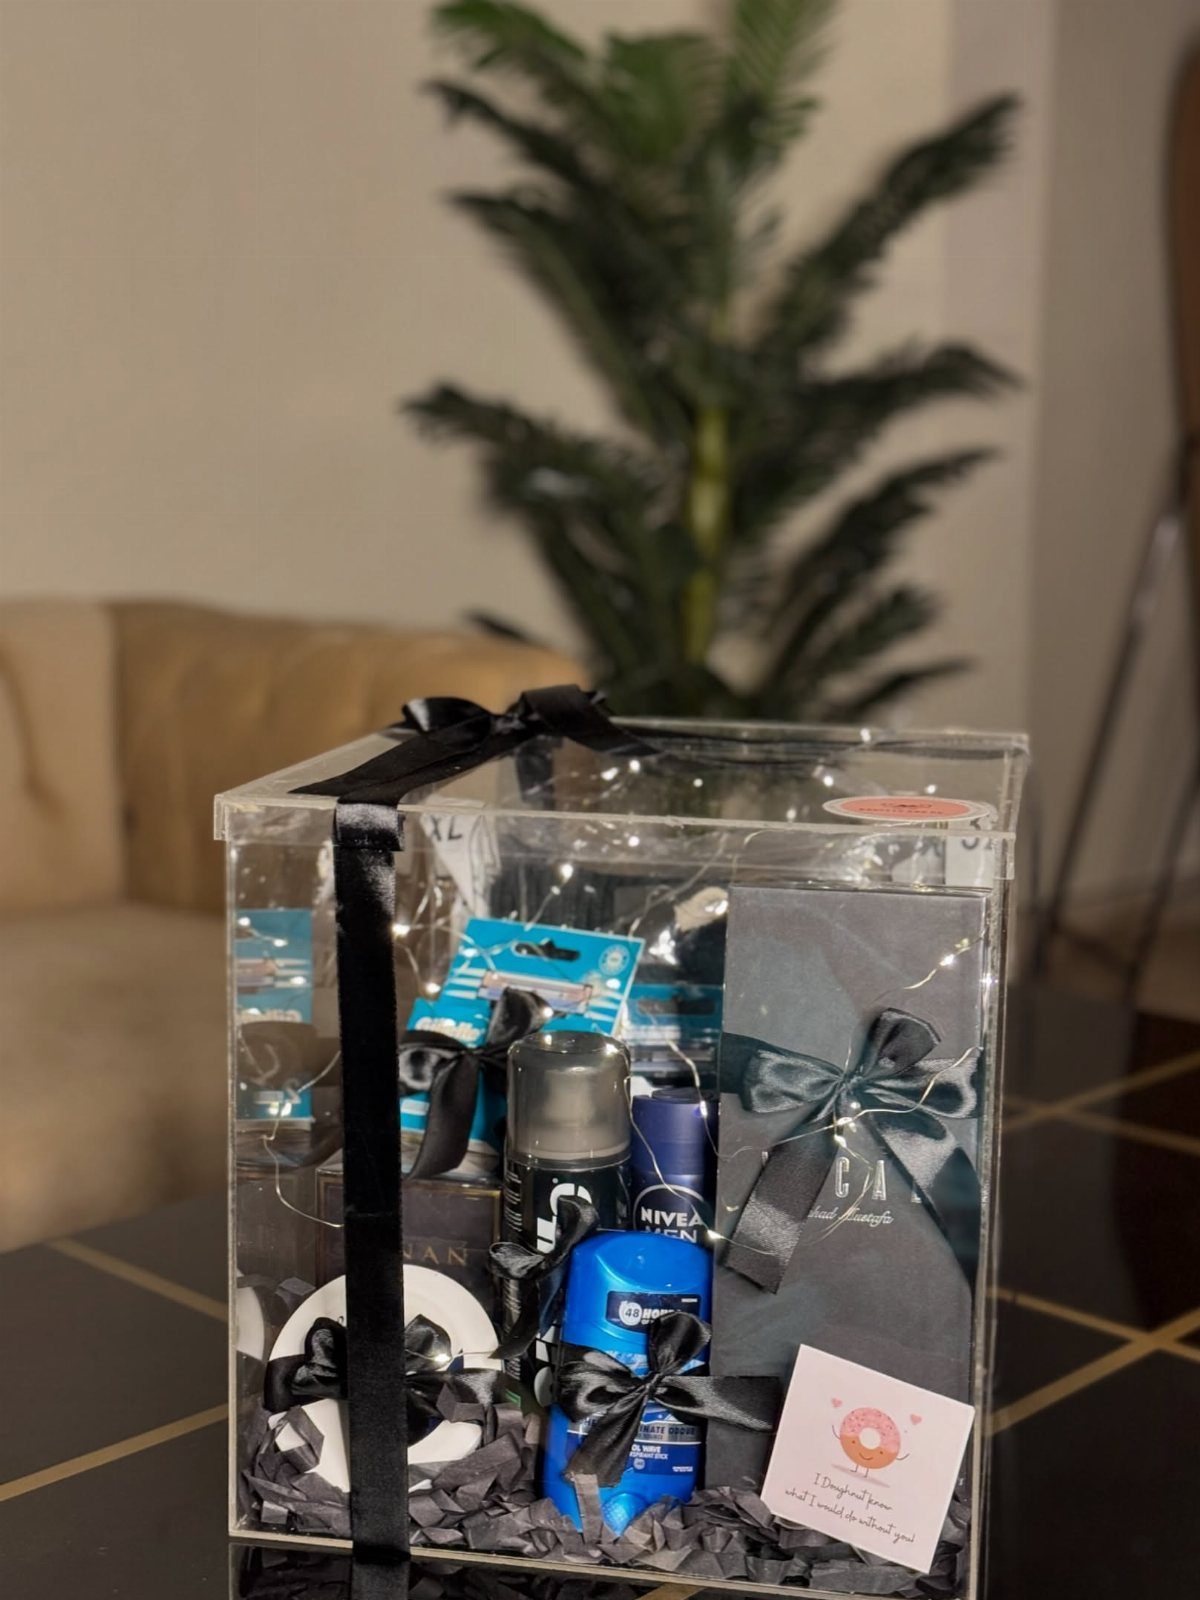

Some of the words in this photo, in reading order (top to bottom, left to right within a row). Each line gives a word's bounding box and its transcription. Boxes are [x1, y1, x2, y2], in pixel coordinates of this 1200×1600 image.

[429, 815, 463, 841] XL
[641, 1206, 703, 1227] NIVEA
[625, 1308, 640, 1318] 48
[814, 1473, 821, 1485] I
[820, 1476, 867, 1500] Doughnut
[785, 1488, 808, 1501] what
[809, 1495, 816, 1507] I
[845, 1510, 857, 1522] do
[859, 1516, 896, 1536] without
